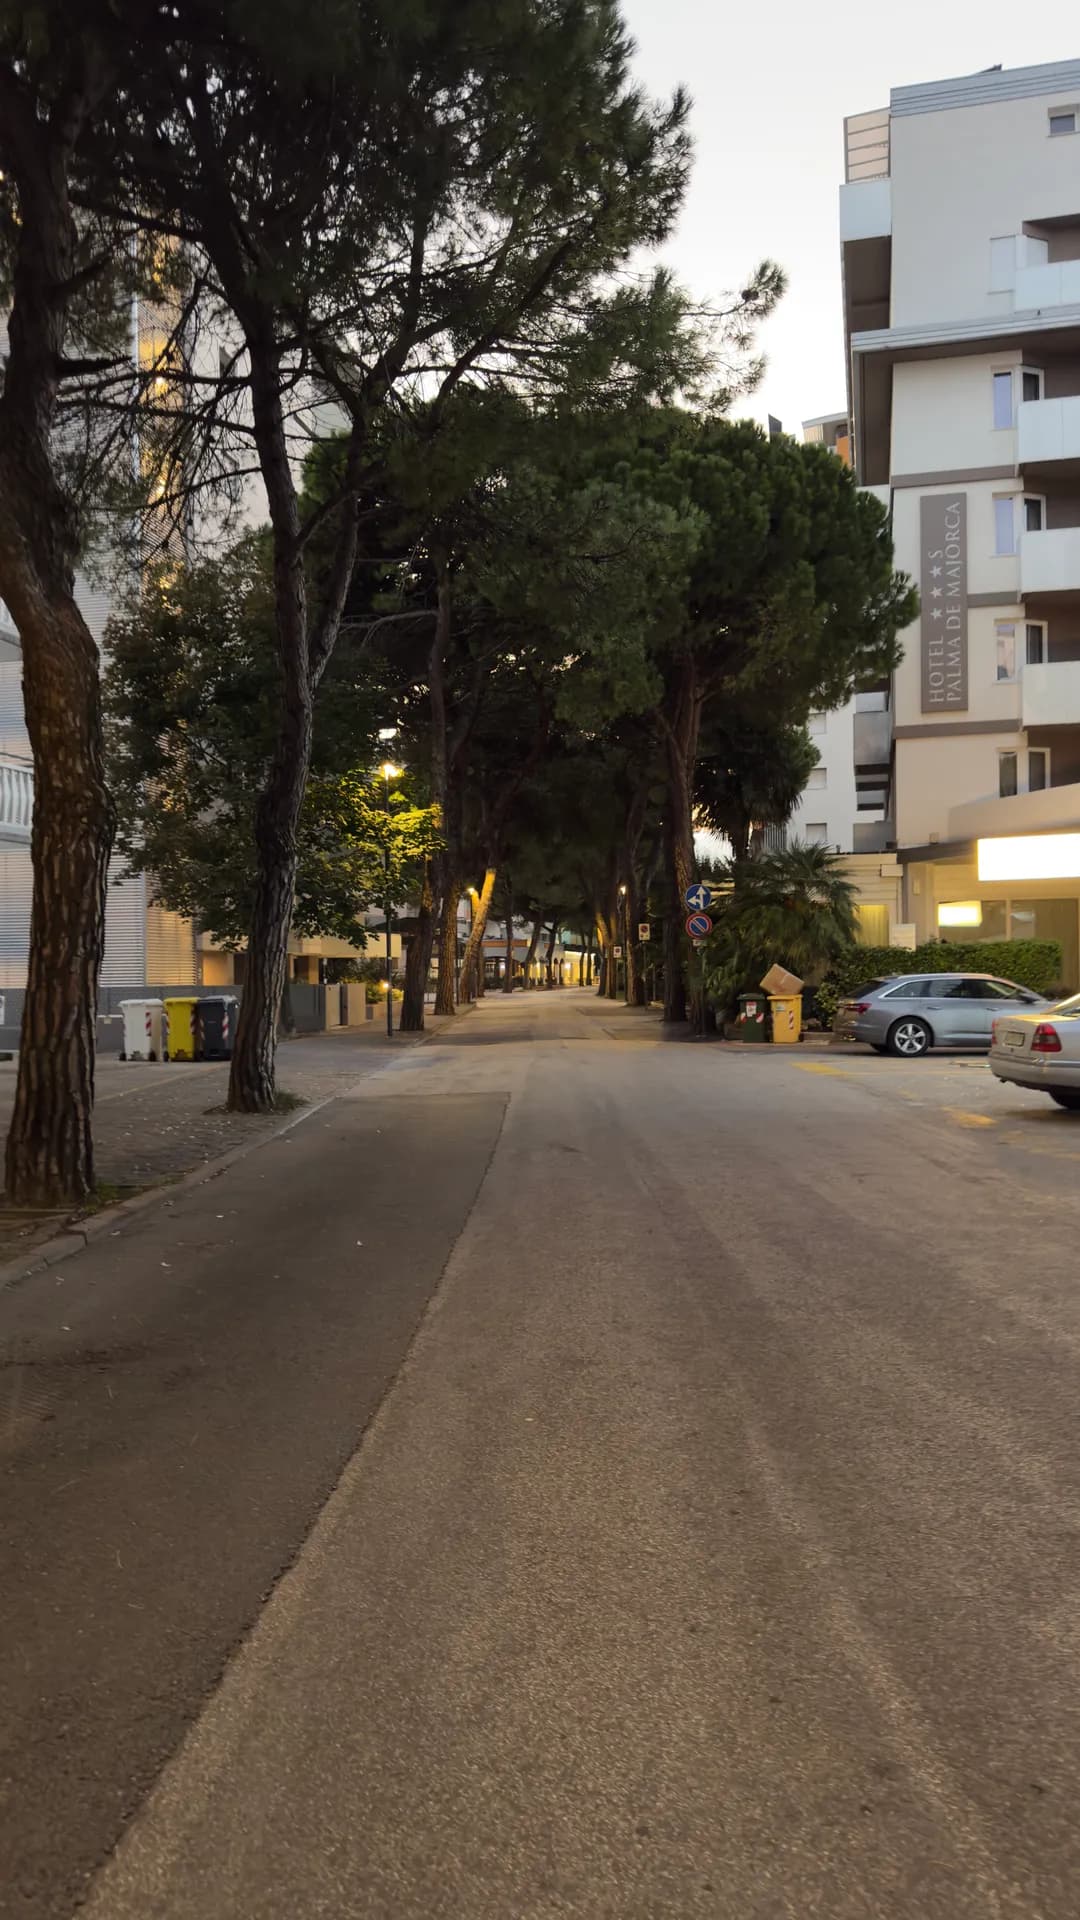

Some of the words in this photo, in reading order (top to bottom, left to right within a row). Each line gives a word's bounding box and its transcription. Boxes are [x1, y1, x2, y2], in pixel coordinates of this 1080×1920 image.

[928, 550, 943, 559] S
[946, 603, 961, 629] DE
[929, 635, 944, 703] HOTEL
[946, 636, 961, 702] PALMA
